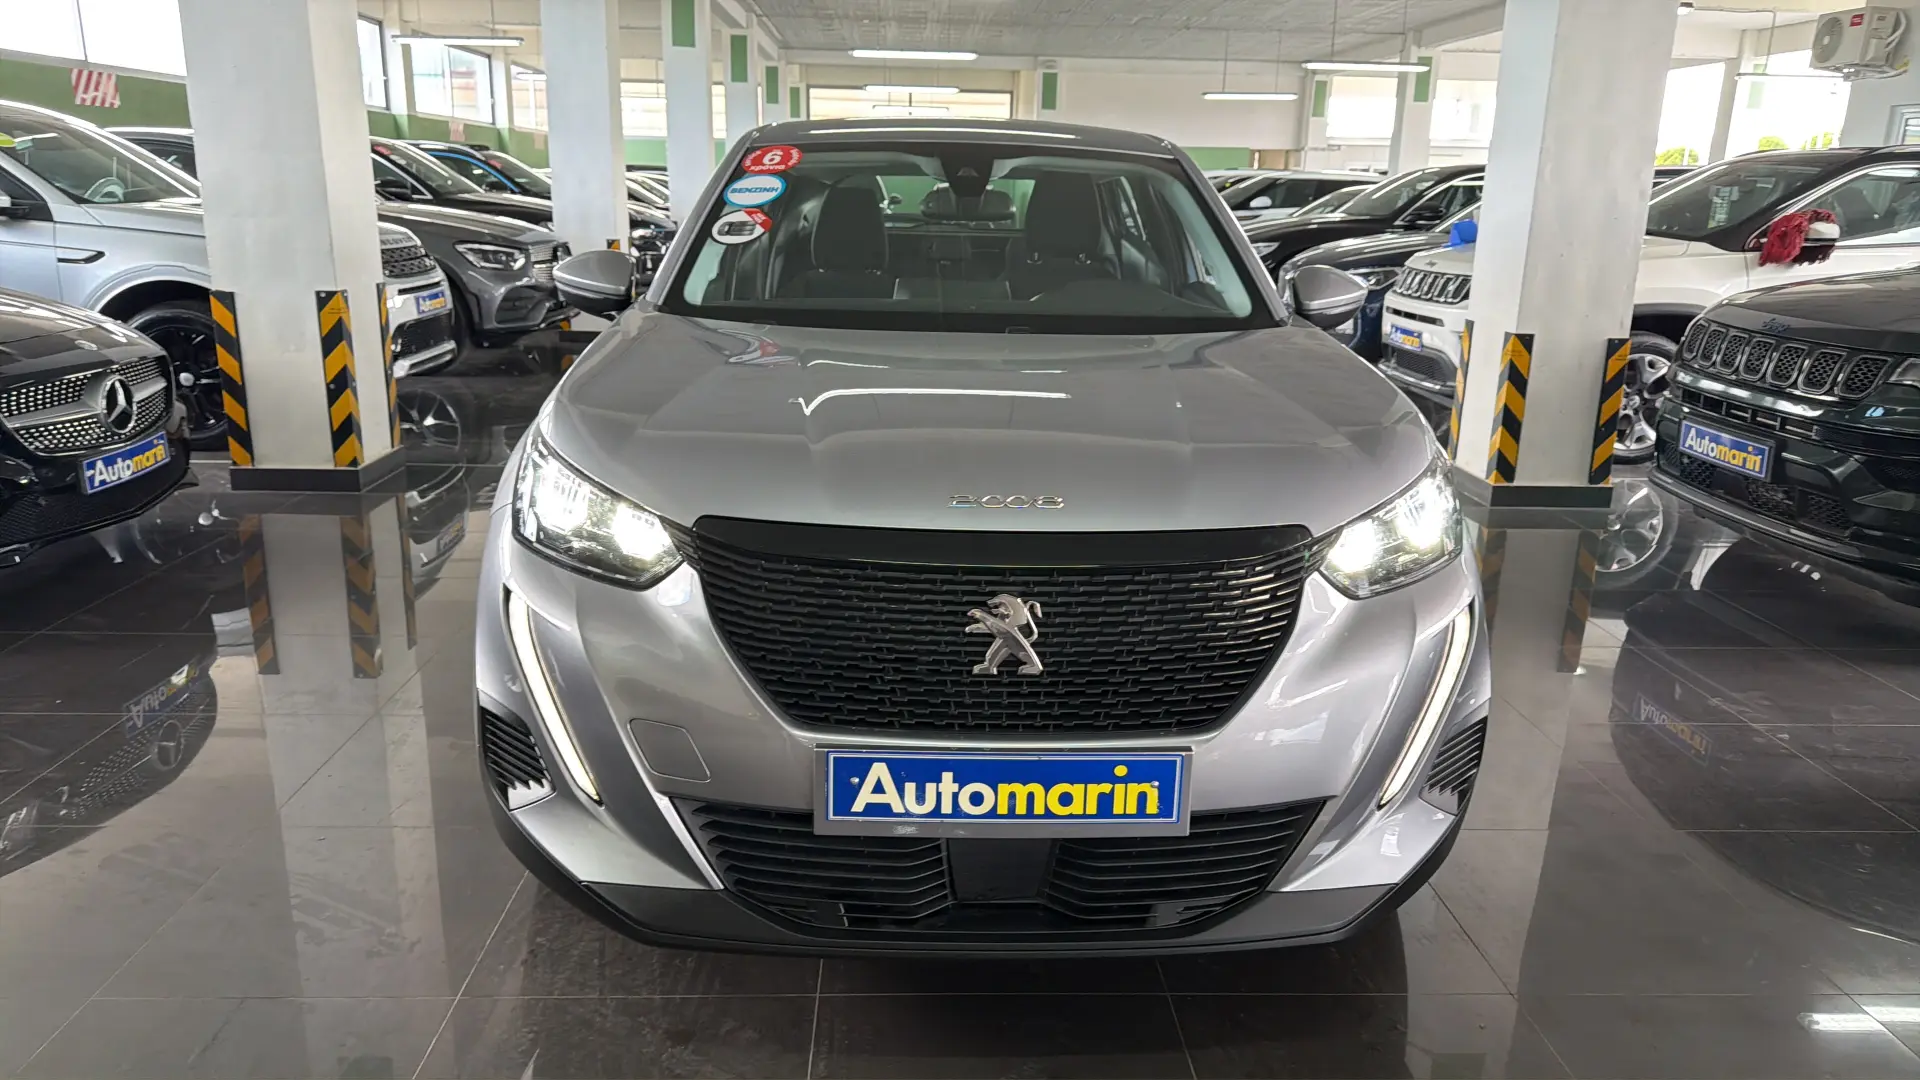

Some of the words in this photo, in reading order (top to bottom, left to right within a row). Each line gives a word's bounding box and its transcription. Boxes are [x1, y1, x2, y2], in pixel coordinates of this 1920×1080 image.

[762, 151, 784, 165] 6
[1684, 427, 1762, 473] Automarin
[947, 494, 1065, 509] 2008
[850, 762, 1159, 816] Automarin
